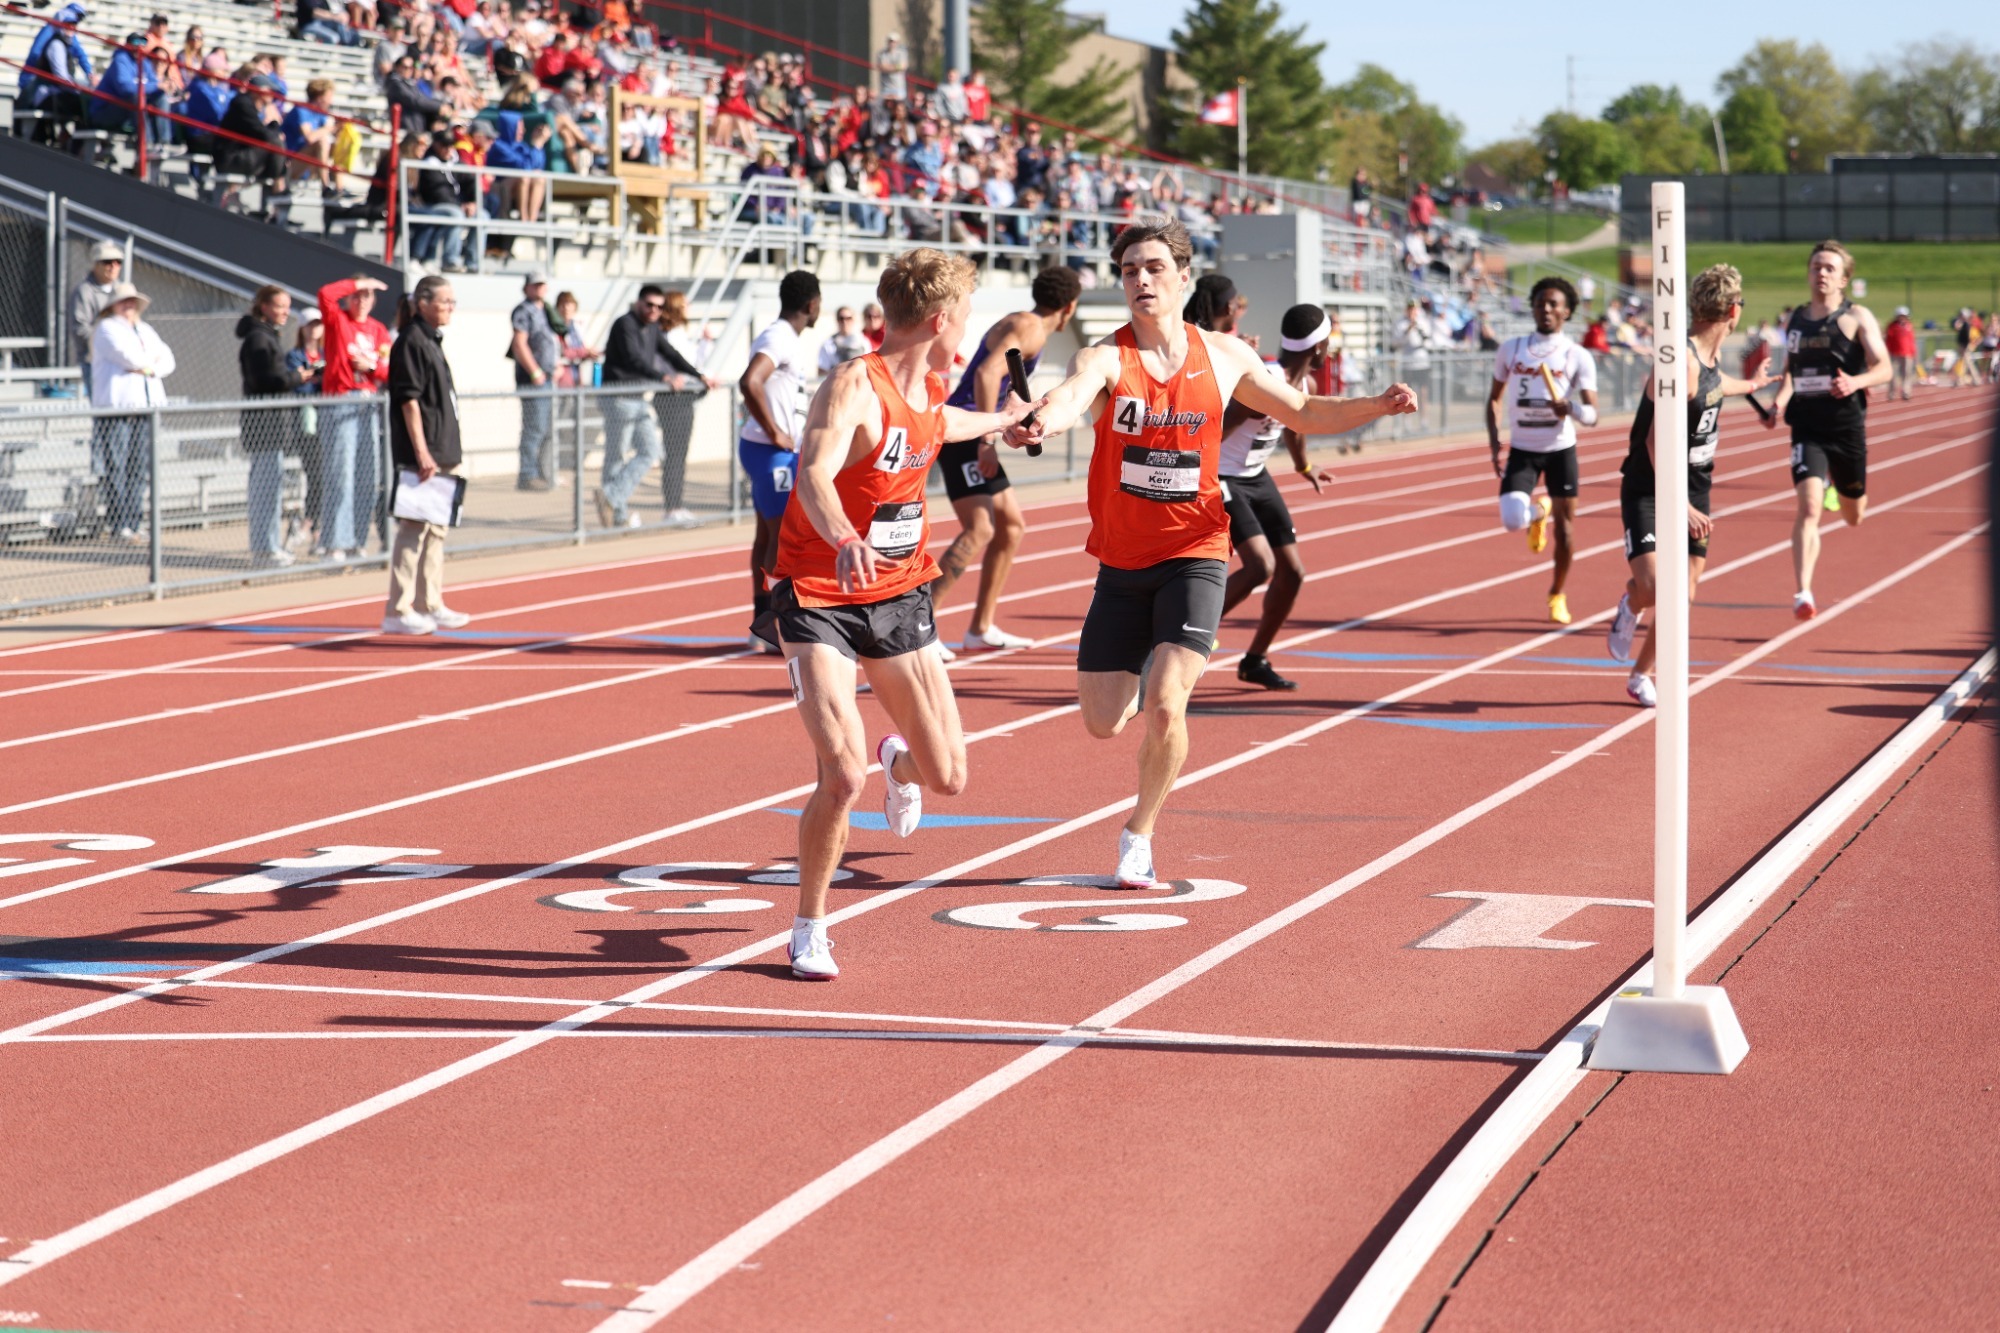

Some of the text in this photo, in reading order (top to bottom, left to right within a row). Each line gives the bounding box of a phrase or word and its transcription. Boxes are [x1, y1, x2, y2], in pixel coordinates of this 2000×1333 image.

[1656, 210, 1676, 398] FINISH
[1519, 377, 1528, 397] 5
[1118, 400, 1137, 432] 4
[1143, 404, 1207, 436] artburg
[883, 431, 902, 470] 4
[778, 470, 789, 489] 2
[967, 463, 980, 484] 6
[1148, 475, 1172, 485] Kerr
[180, 845, 474, 894] 4
[540, 861, 855, 914] 3
[931, 873, 1247, 932] 2
[1405, 890, 1655, 950] 1
